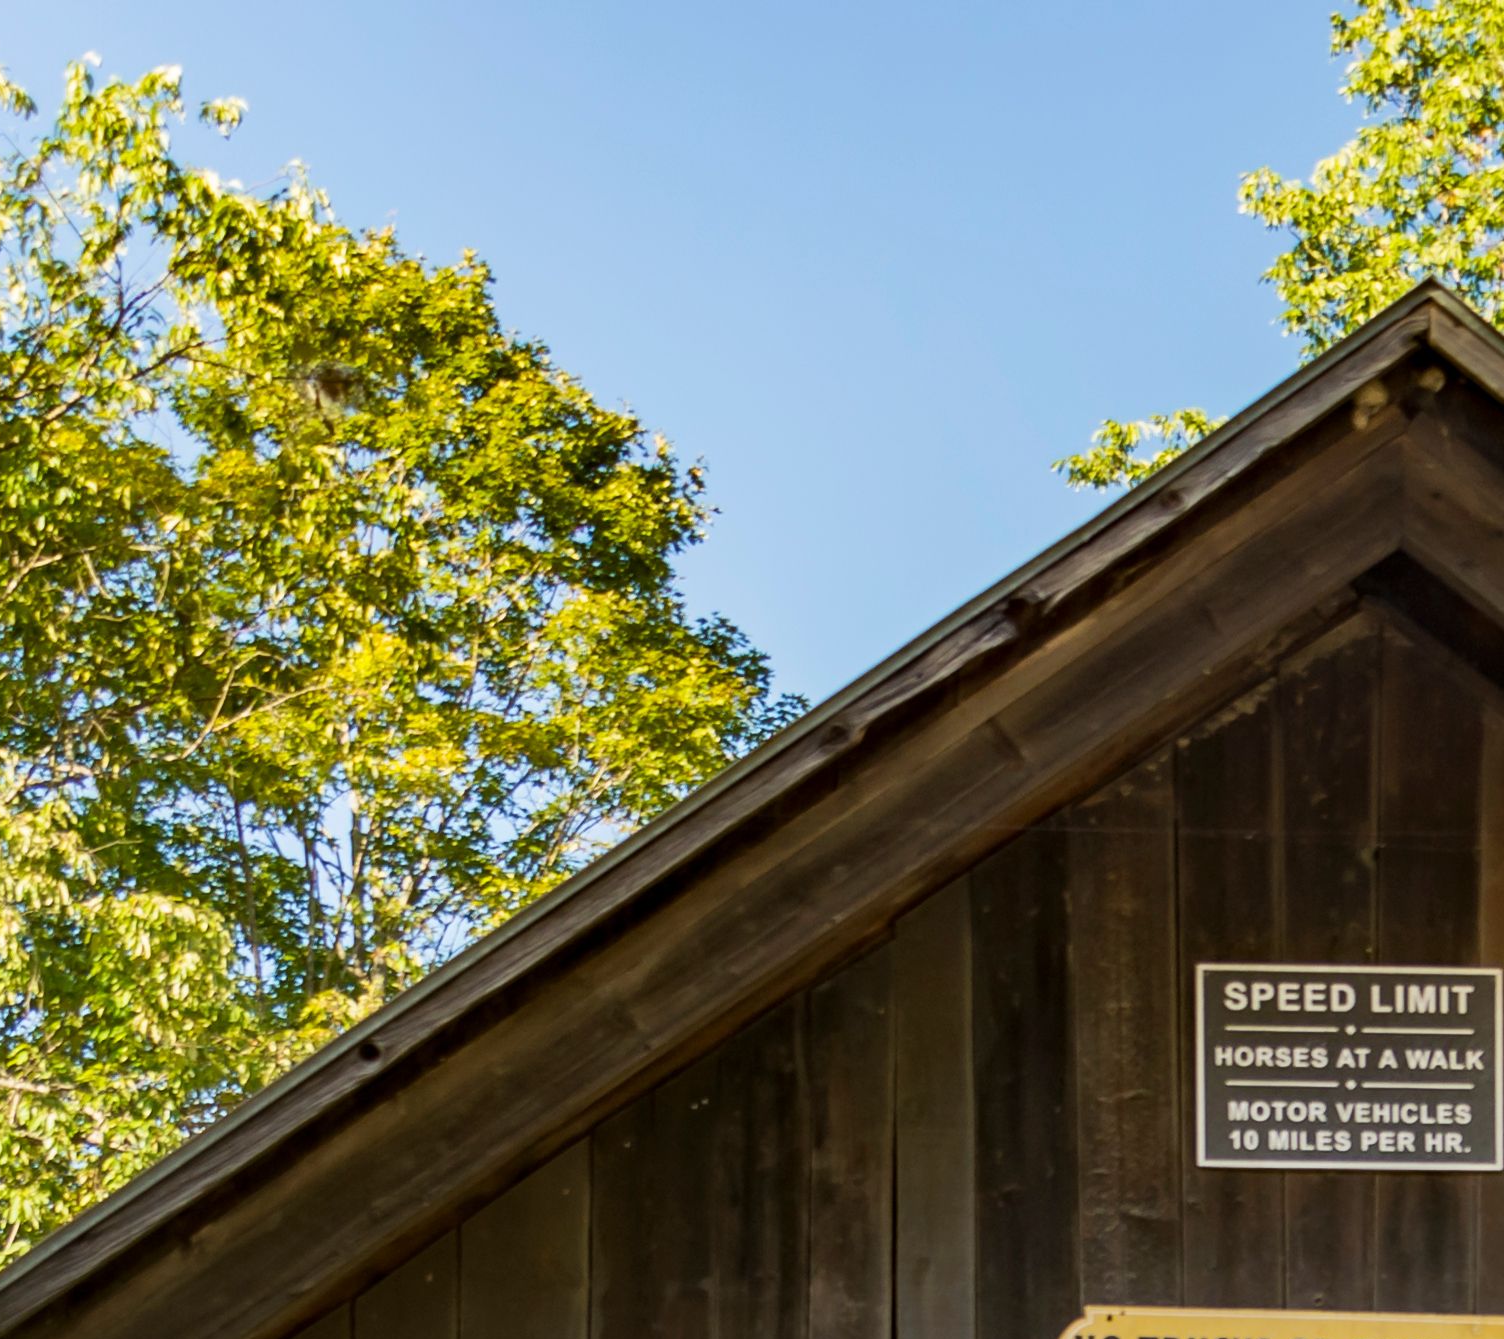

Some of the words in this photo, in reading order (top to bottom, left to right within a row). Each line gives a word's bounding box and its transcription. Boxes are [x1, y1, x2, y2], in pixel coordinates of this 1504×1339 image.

[1225, 982, 1356, 1012] SPEED
[1371, 985, 1474, 1014] LIMIT
[1215, 1046, 1328, 1068] HORSES
[1336, 1048, 1371, 1068] AT
[1378, 1049, 1398, 1069] A
[1405, 1049, 1484, 1070] WALK
[1228, 1101, 1327, 1122] MOTOR
[1335, 1102, 1472, 1125] VEHICLES
[1229, 1129, 1259, 1151] 10
[1268, 1129, 1352, 1152] MILES
[1360, 1131, 1415, 1152] PER
[1425, 1132, 1471, 1153] HR.
